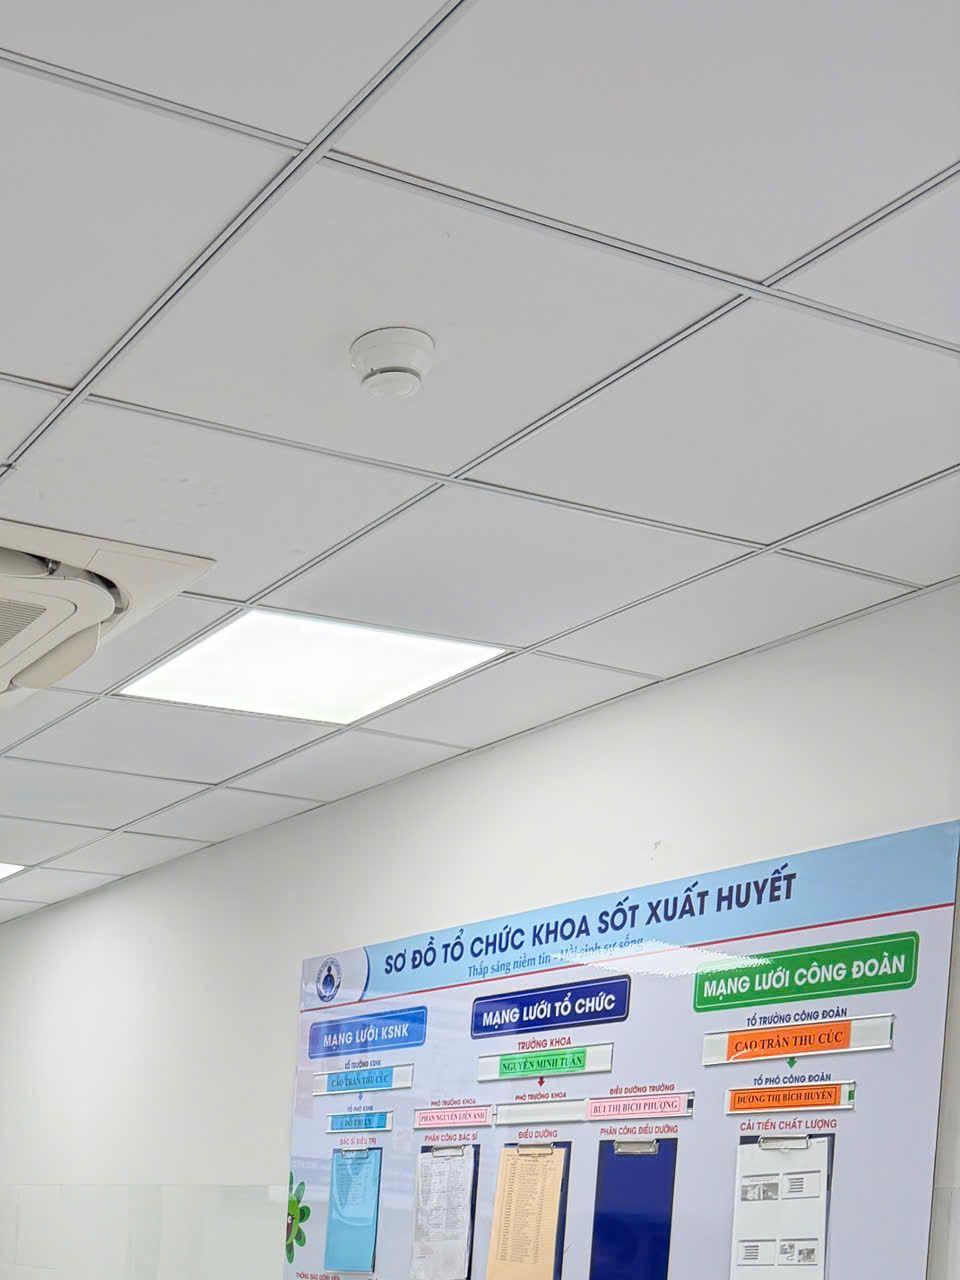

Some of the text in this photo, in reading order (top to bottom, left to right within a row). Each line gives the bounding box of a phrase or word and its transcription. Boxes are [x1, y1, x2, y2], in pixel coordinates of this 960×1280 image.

[385, 862, 797, 975] SƠ ĐỒ TỔ CHỨC KHOA SỐT XUẤT HUYẾT
[490, 959, 511, 974] sáng
[512, 952, 536, 969] niềm
[538, 952, 551, 965] tin
[703, 952, 906, 1000] MẠNG LƯỚI CÔNG ĐOÀN
[482, 991, 616, 1030] MẠNG LƯỚI TỔ CHỨC
[759, 1012, 792, 1026] TRƯỞNG
[793, 1009, 820, 1023] CÔNG
[822, 1007, 848, 1020] ĐOÀN
[323, 1023, 409, 1050] MẠNG LƯỚI KSNK
[518, 1036, 571, 1050] TRƯỞNG KHOA
[735, 1040, 758, 1053] CAO
[791, 1035, 816, 1047] THU
[818, 1029, 843, 1044] CÚC
[535, 1058, 558, 1069] MINH
[765, 1075, 780, 1085] PHÓ
[782, 1074, 806, 1084] CÔNG
[808, 1072, 831, 1082] ĐOÀN
[767, 1094, 781, 1104] THỊ
[782, 1091, 803, 1102] BÍCH
[608, 1103, 621, 1114] THỊ
[600, 1126, 617, 1136] PHÂN
[618, 1125, 637, 1135] CÔNG
[654, 1124, 678, 1134] DƯỠNG
[740, 1117, 837, 1131] CẢI TIẾN CHẤT LƯỢNG
[534, 1129, 558, 1139] DƯỠNG
